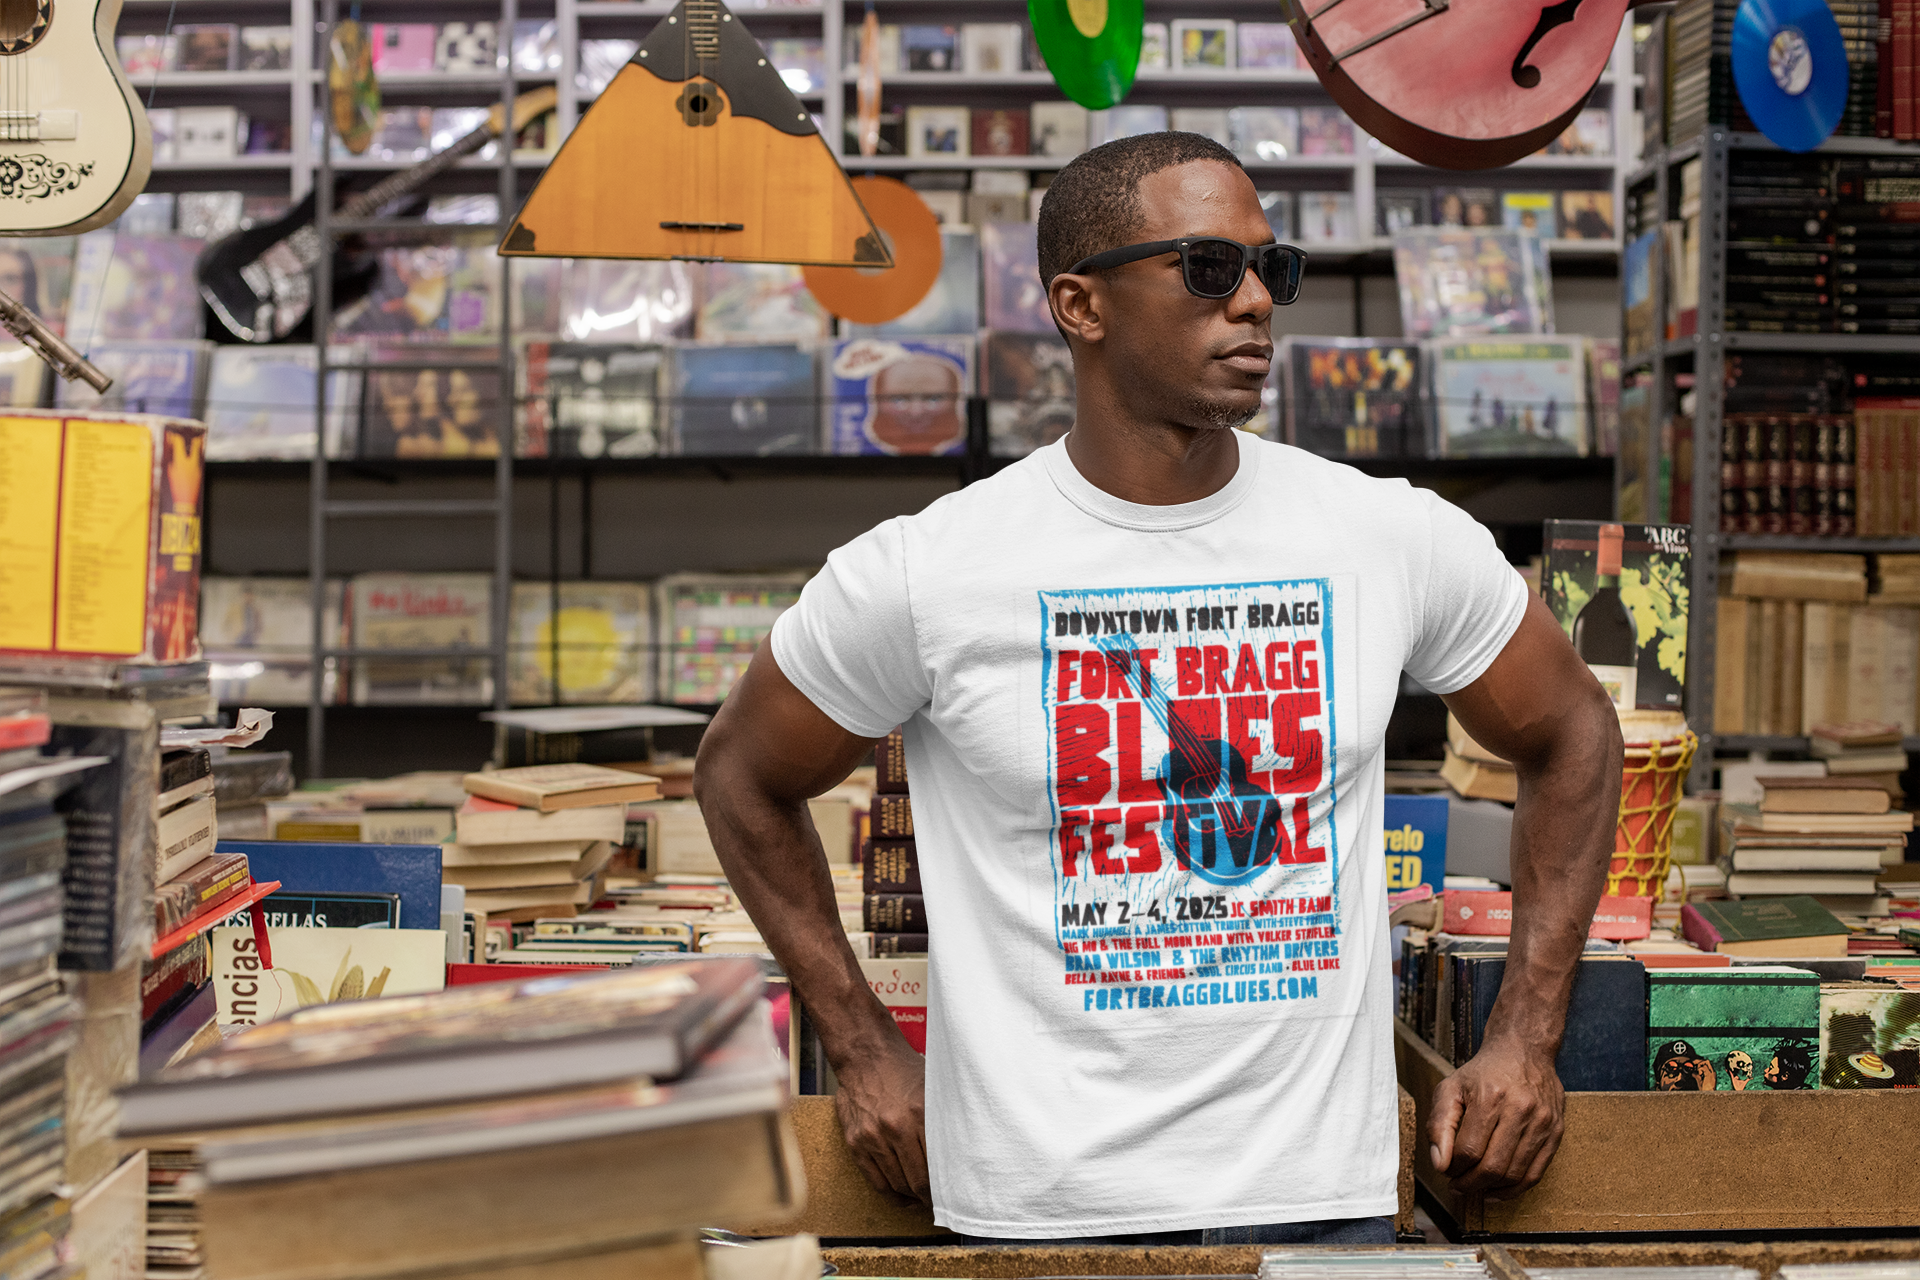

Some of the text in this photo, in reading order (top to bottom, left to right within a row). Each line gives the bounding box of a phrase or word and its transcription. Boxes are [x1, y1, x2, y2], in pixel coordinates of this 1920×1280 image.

[1648, 527, 1686, 544] ABC
[1055, 602, 1320, 637] DOWNTOWN FORT BRAGG
[1057, 640, 1320, 702] FORT BRAGG
[1056, 692, 1323, 807] BLUES
[881, 797, 890, 834] AMADO
[1058, 797, 1327, 877] FESTIVAL
[874, 847, 882, 883] AMADO
[1386, 855, 1422, 888] ED
[1062, 902, 1108, 927] MAY
[1175, 895, 1228, 921] 2025
[1230, 895, 1331, 918] JC SMITH BAND
[1487, 909, 1512, 920] INSO
[1062, 928, 1090, 940] MARK
[1135, 924, 1143, 935] A
[1146, 923, 1176, 935] JAMES
[1179, 921, 1212, 934] COTTON
[1215, 920, 1250, 931] TRIBUTE
[1254, 917, 1277, 929] WITH
[1280, 915, 1305, 928] STEVE
[1063, 926, 1336, 954] BIG MO & THE FULL MOON BAND WITH VOLKER STRIFLER
[1065, 940, 1339, 972] BRAD WILSON & THE RHYTHM DRIVERS
[1065, 972, 1097, 985] BELLA
[1101, 971, 1131, 983] RAYNE
[1135, 970, 1143, 982] &
[1146, 968, 1186, 980] FRIENDS
[1196, 965, 1222, 978] SOUL
[1225, 963, 1256, 976] CIRCUS
[1259, 962, 1283, 974] BAND
[1292, 959, 1315, 971] BLUE
[1084, 976, 1318, 1011] FORTBRAGGBLUES.COM
